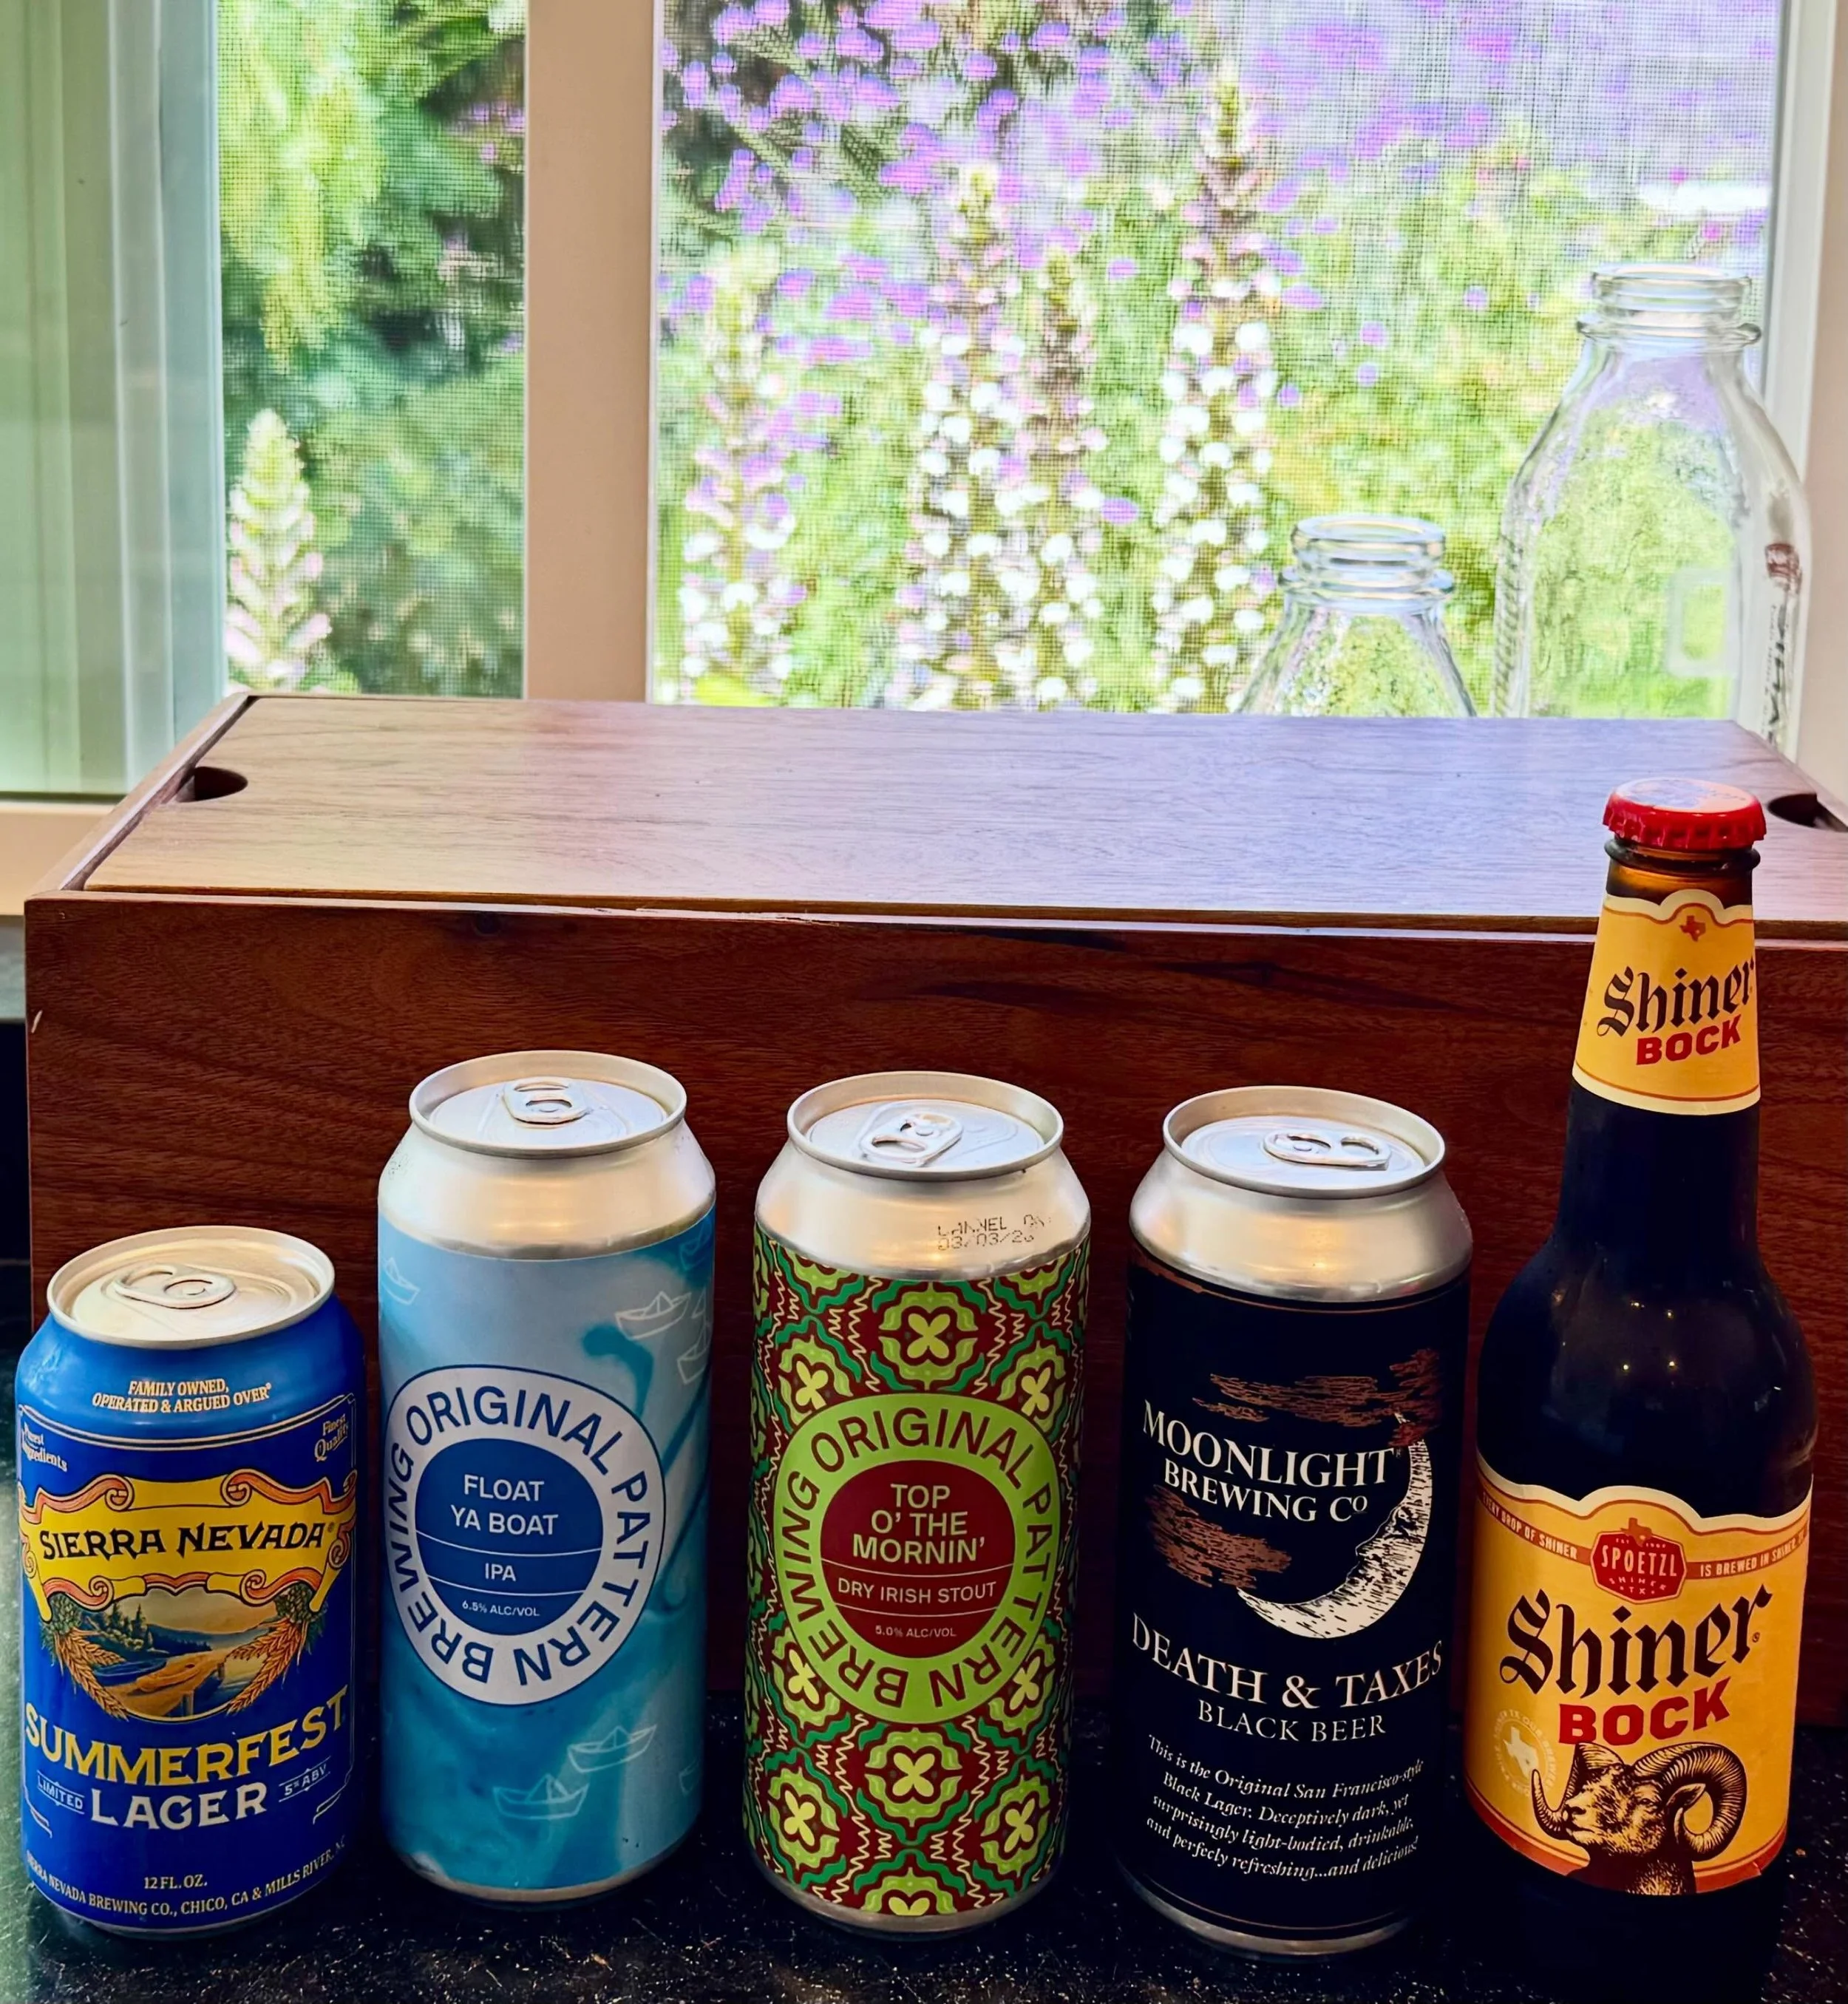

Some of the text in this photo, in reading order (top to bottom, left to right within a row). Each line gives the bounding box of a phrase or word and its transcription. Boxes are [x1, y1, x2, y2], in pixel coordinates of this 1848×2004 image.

[1597, 955, 1755, 1037] Shiner
[1636, 1014, 1742, 1065] BOCK
[92, 1392, 158, 1413] OPERATED
[160, 1399, 173, 1413] &
[173, 1396, 231, 1413] ARGUED
[128, 1379, 228, 1396] FAMILY OWNED,
[1142, 1399, 1395, 1488] MOONLIGHT
[463, 1474, 545, 1501] FLOAT
[890, 1483, 951, 1509] TOP
[1164, 1458, 1317, 1523] BREWING
[387, 1385, 651, 1687] ORIGINAL PATTERN BREWING
[450, 1504, 558, 1536] YA BOAT
[872, 1510, 968, 1537] O' THE
[1501, 1509, 1522, 1533] DROP
[1524, 1526, 1537, 1541] OF
[1539, 1534, 1577, 1560] SHINER
[39, 1521, 322, 1560] SIERRA NEVADA
[781, 1407, 1053, 1708] ORIGINAL PATTERN BREWING
[852, 1533, 985, 1565] MORNIN'
[485, 1562, 517, 1582] IPA
[1601, 1544, 1677, 1577] SPOETZL
[1700, 1564, 1711, 1577] IS
[1716, 1557, 1757, 1575] BREWED
[1760, 1552, 1770, 1566] IN
[462, 1600, 541, 1617] 6.5% ALC/VOL
[838, 1577, 997, 1604] DRY IRISH STOUT
[875, 1625, 957, 1638] 5.0% ALC/VOL
[1499, 1583, 1773, 1699] Shiner
[1132, 1612, 1442, 1709] DEATH & TAXES
[1198, 1699, 1386, 1743] BLACK BEER
[1557, 1677, 1731, 1747] BOCK
[25, 1684, 348, 1787] SUMMERFEST
[302, 1763, 327, 1788] ABV
[1149, 1734, 1173, 1762] This
[1175, 1753, 1187, 1769] is
[1189, 1761, 1211, 1779] the
[1215, 1770, 1291, 1796] Original
[1294, 1784, 1326, 1798] San
[38, 1775, 83, 1810] LIMITED
[91, 1781, 267, 1830] LAGER
[1163, 1771, 1200, 1802] Black
[1258, 1805, 1349, 1829] Deceptively
[1352, 1800, 1390, 1824] dark,
[1146, 1818, 1172, 1839] and
[1153, 1796, 1239, 1844] surprisingly
[1242, 1829, 1344, 1852] light-bodied,
[49, 1873, 86, 1904] NEVADA
[89, 1893, 147, 1915] BREWING
[151, 1902, 177, 1918] CO.,
[180, 1897, 228, 1915] CHICO,
[231, 1891, 249, 1906] CA
[252, 1886, 262, 1900] &
[265, 1869, 301, 1897] MILLS
[143, 1874, 208, 1889] 12 FL. OZ.
